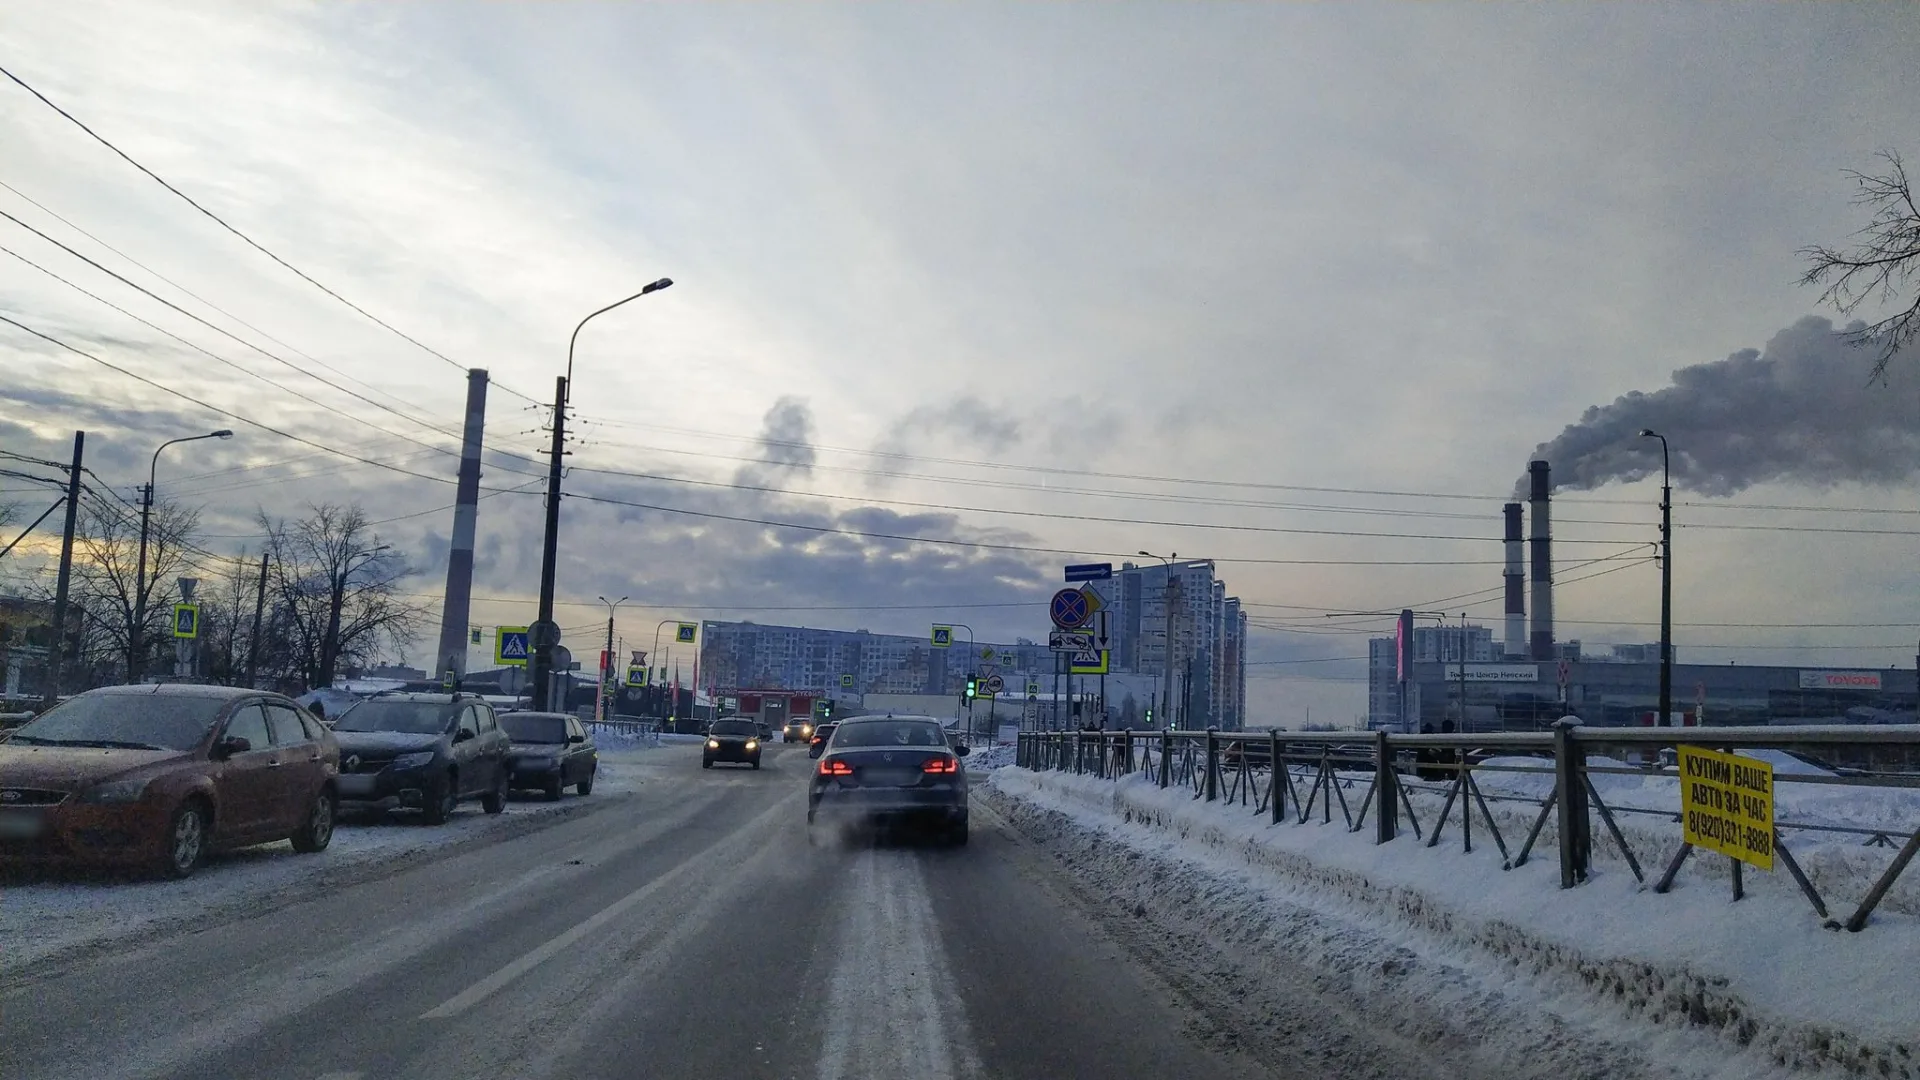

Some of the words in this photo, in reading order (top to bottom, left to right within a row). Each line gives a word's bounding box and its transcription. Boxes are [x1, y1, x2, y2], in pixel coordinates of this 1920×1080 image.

[1825, 674, 1879, 686] TOYOTA
[1686, 754, 1731, 785] КУПИМ
[1734, 764, 1768, 794] ВАШЕ
[1691, 783, 1722, 809] АВТО
[1724, 791, 1741, 815] ЗА
[1743, 795, 1766, 822] ЧАС
